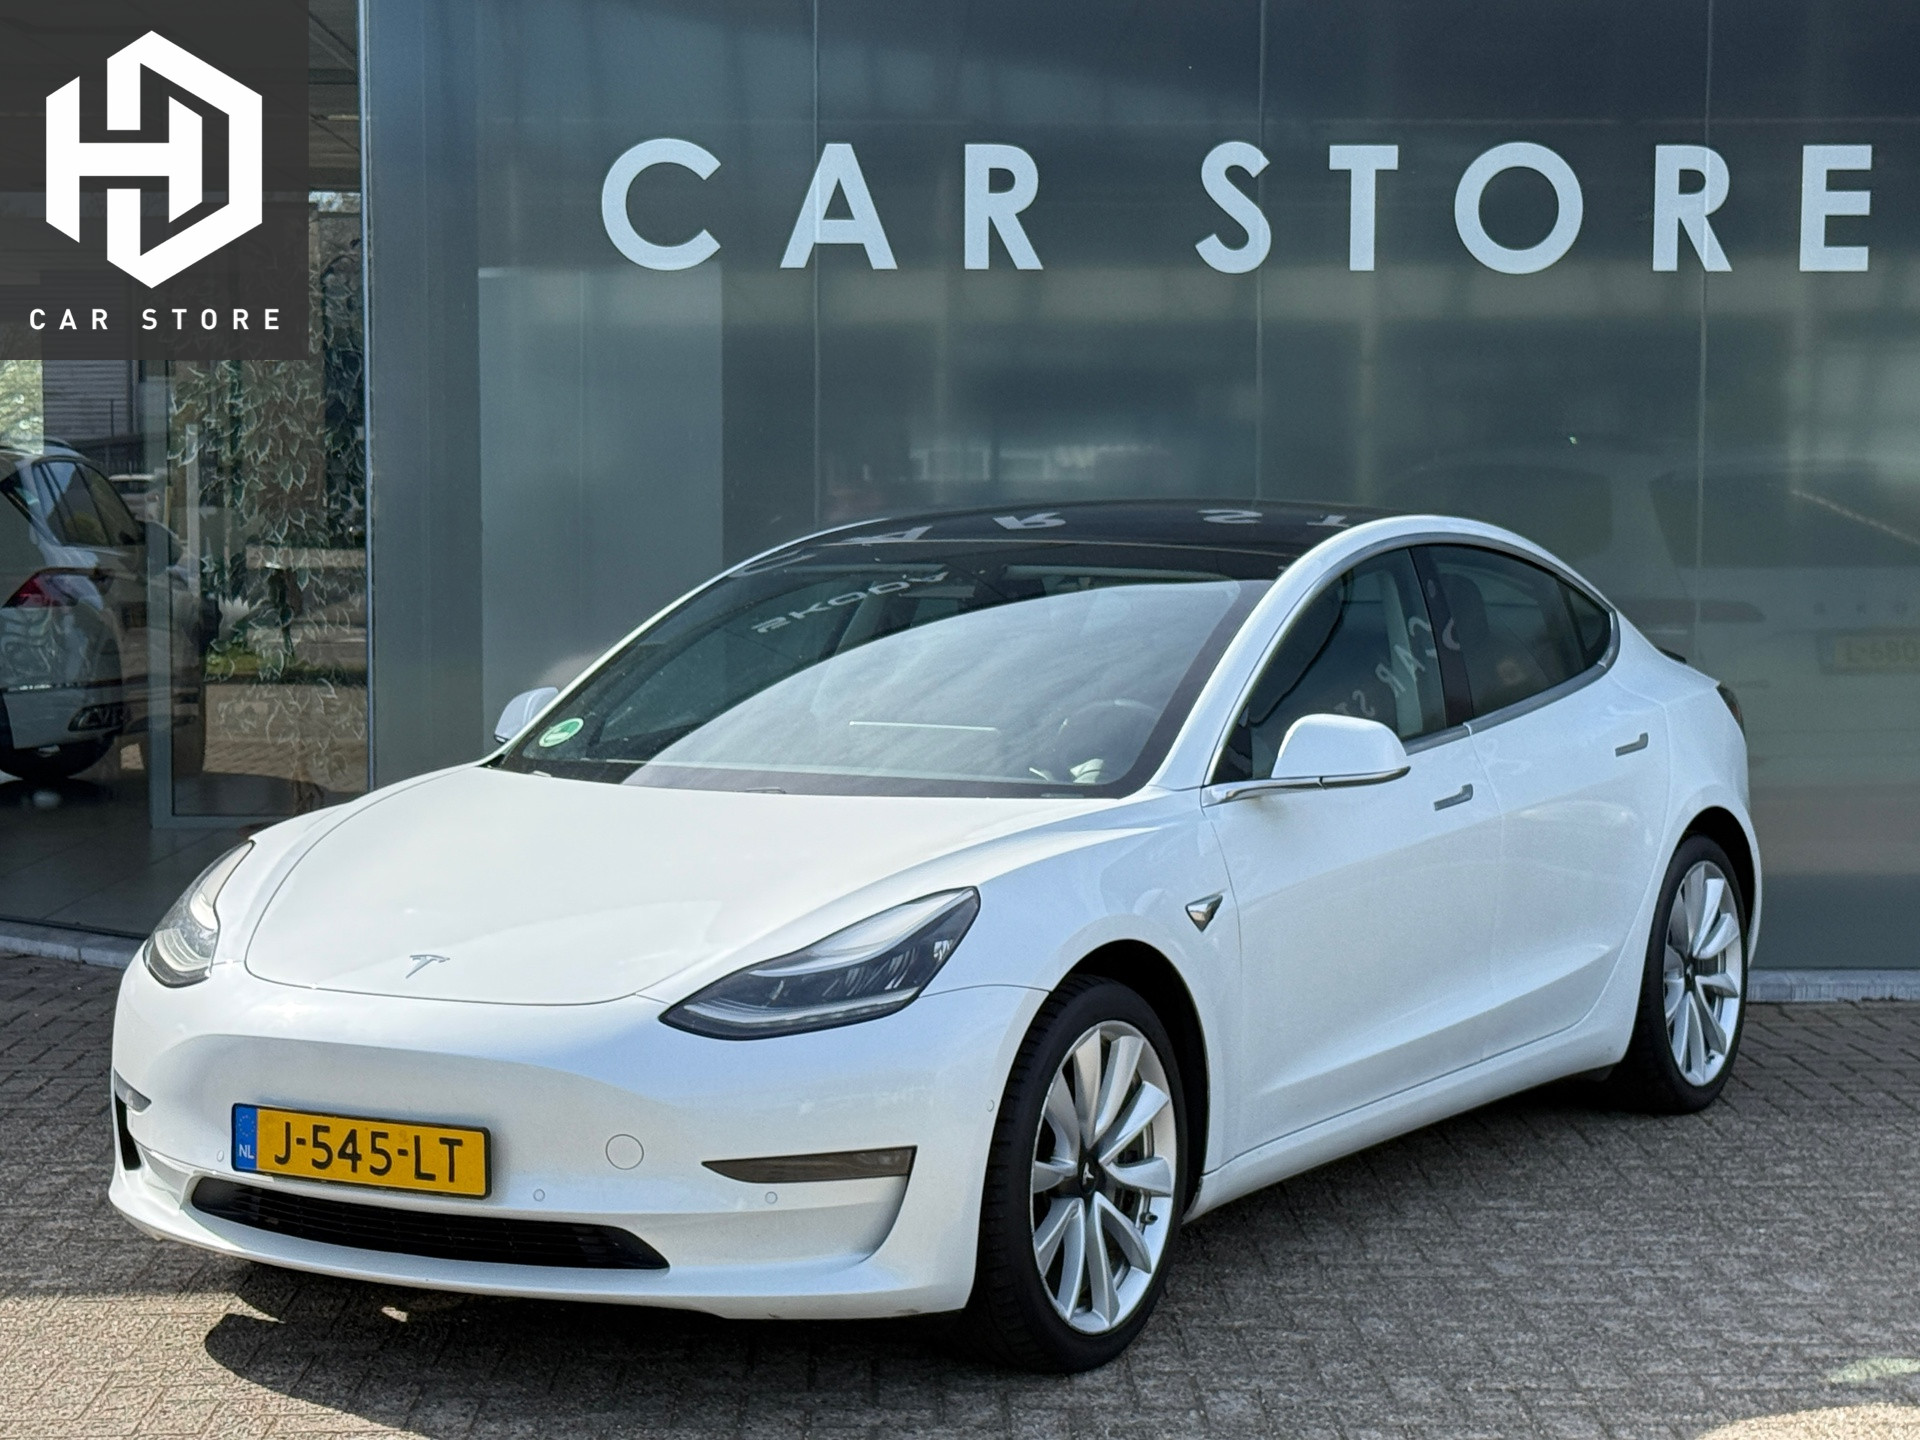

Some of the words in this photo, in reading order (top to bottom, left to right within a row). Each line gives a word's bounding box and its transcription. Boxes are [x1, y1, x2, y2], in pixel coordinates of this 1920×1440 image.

[602, 139, 1042, 270] CAR
[1196, 142, 1871, 273] STORE
[238, 1144, 255, 1160] NL
[274, 1121, 464, 1184] J-545-LT
